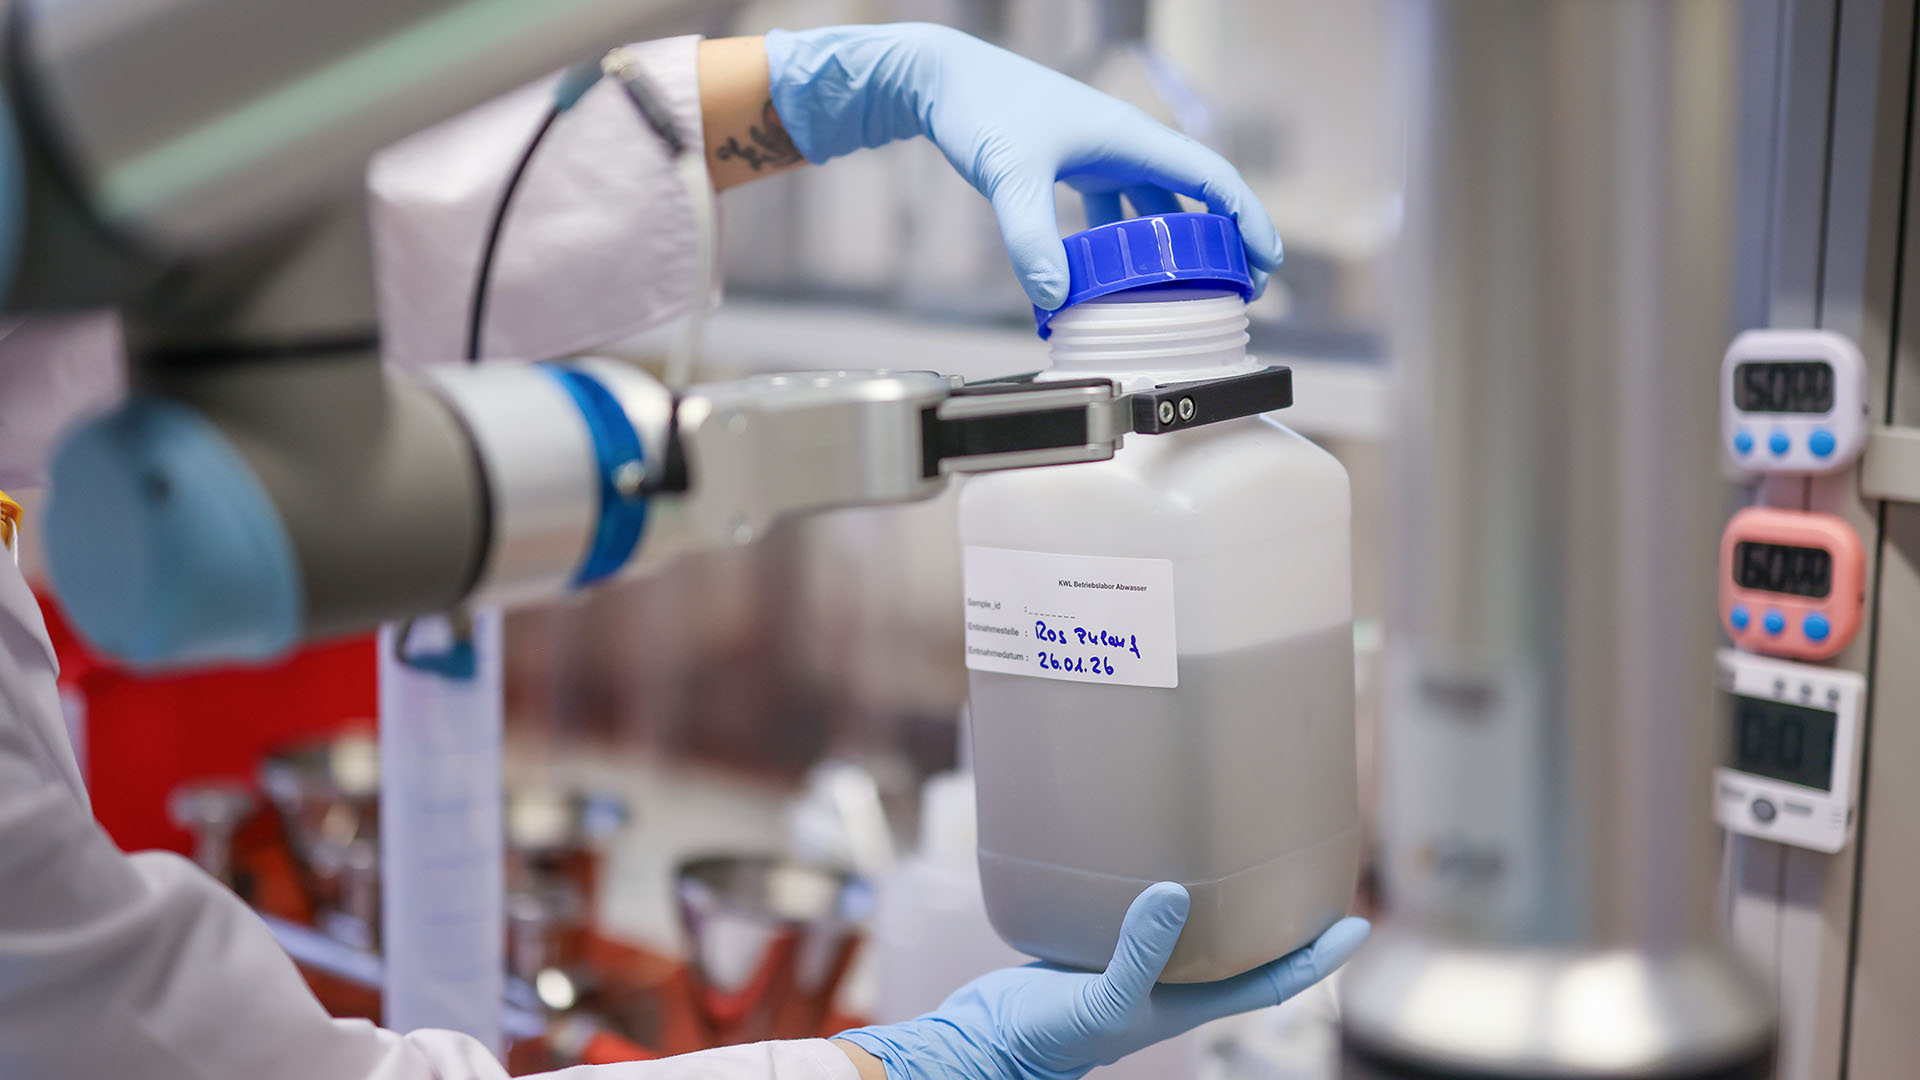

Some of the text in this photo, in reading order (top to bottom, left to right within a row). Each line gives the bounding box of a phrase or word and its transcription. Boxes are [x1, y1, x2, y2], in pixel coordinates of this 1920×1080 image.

[1058, 579, 1148, 592] KWL Betriebslabor Abwasser
[967, 597, 1001, 610] Sample_id
[967, 621, 1020, 637] Entnahmestelle
[1035, 620, 1067, 645] Ros
[967, 645, 1024, 661] Entnahmedatum
[1038, 651, 1115, 676] 26.01.26
